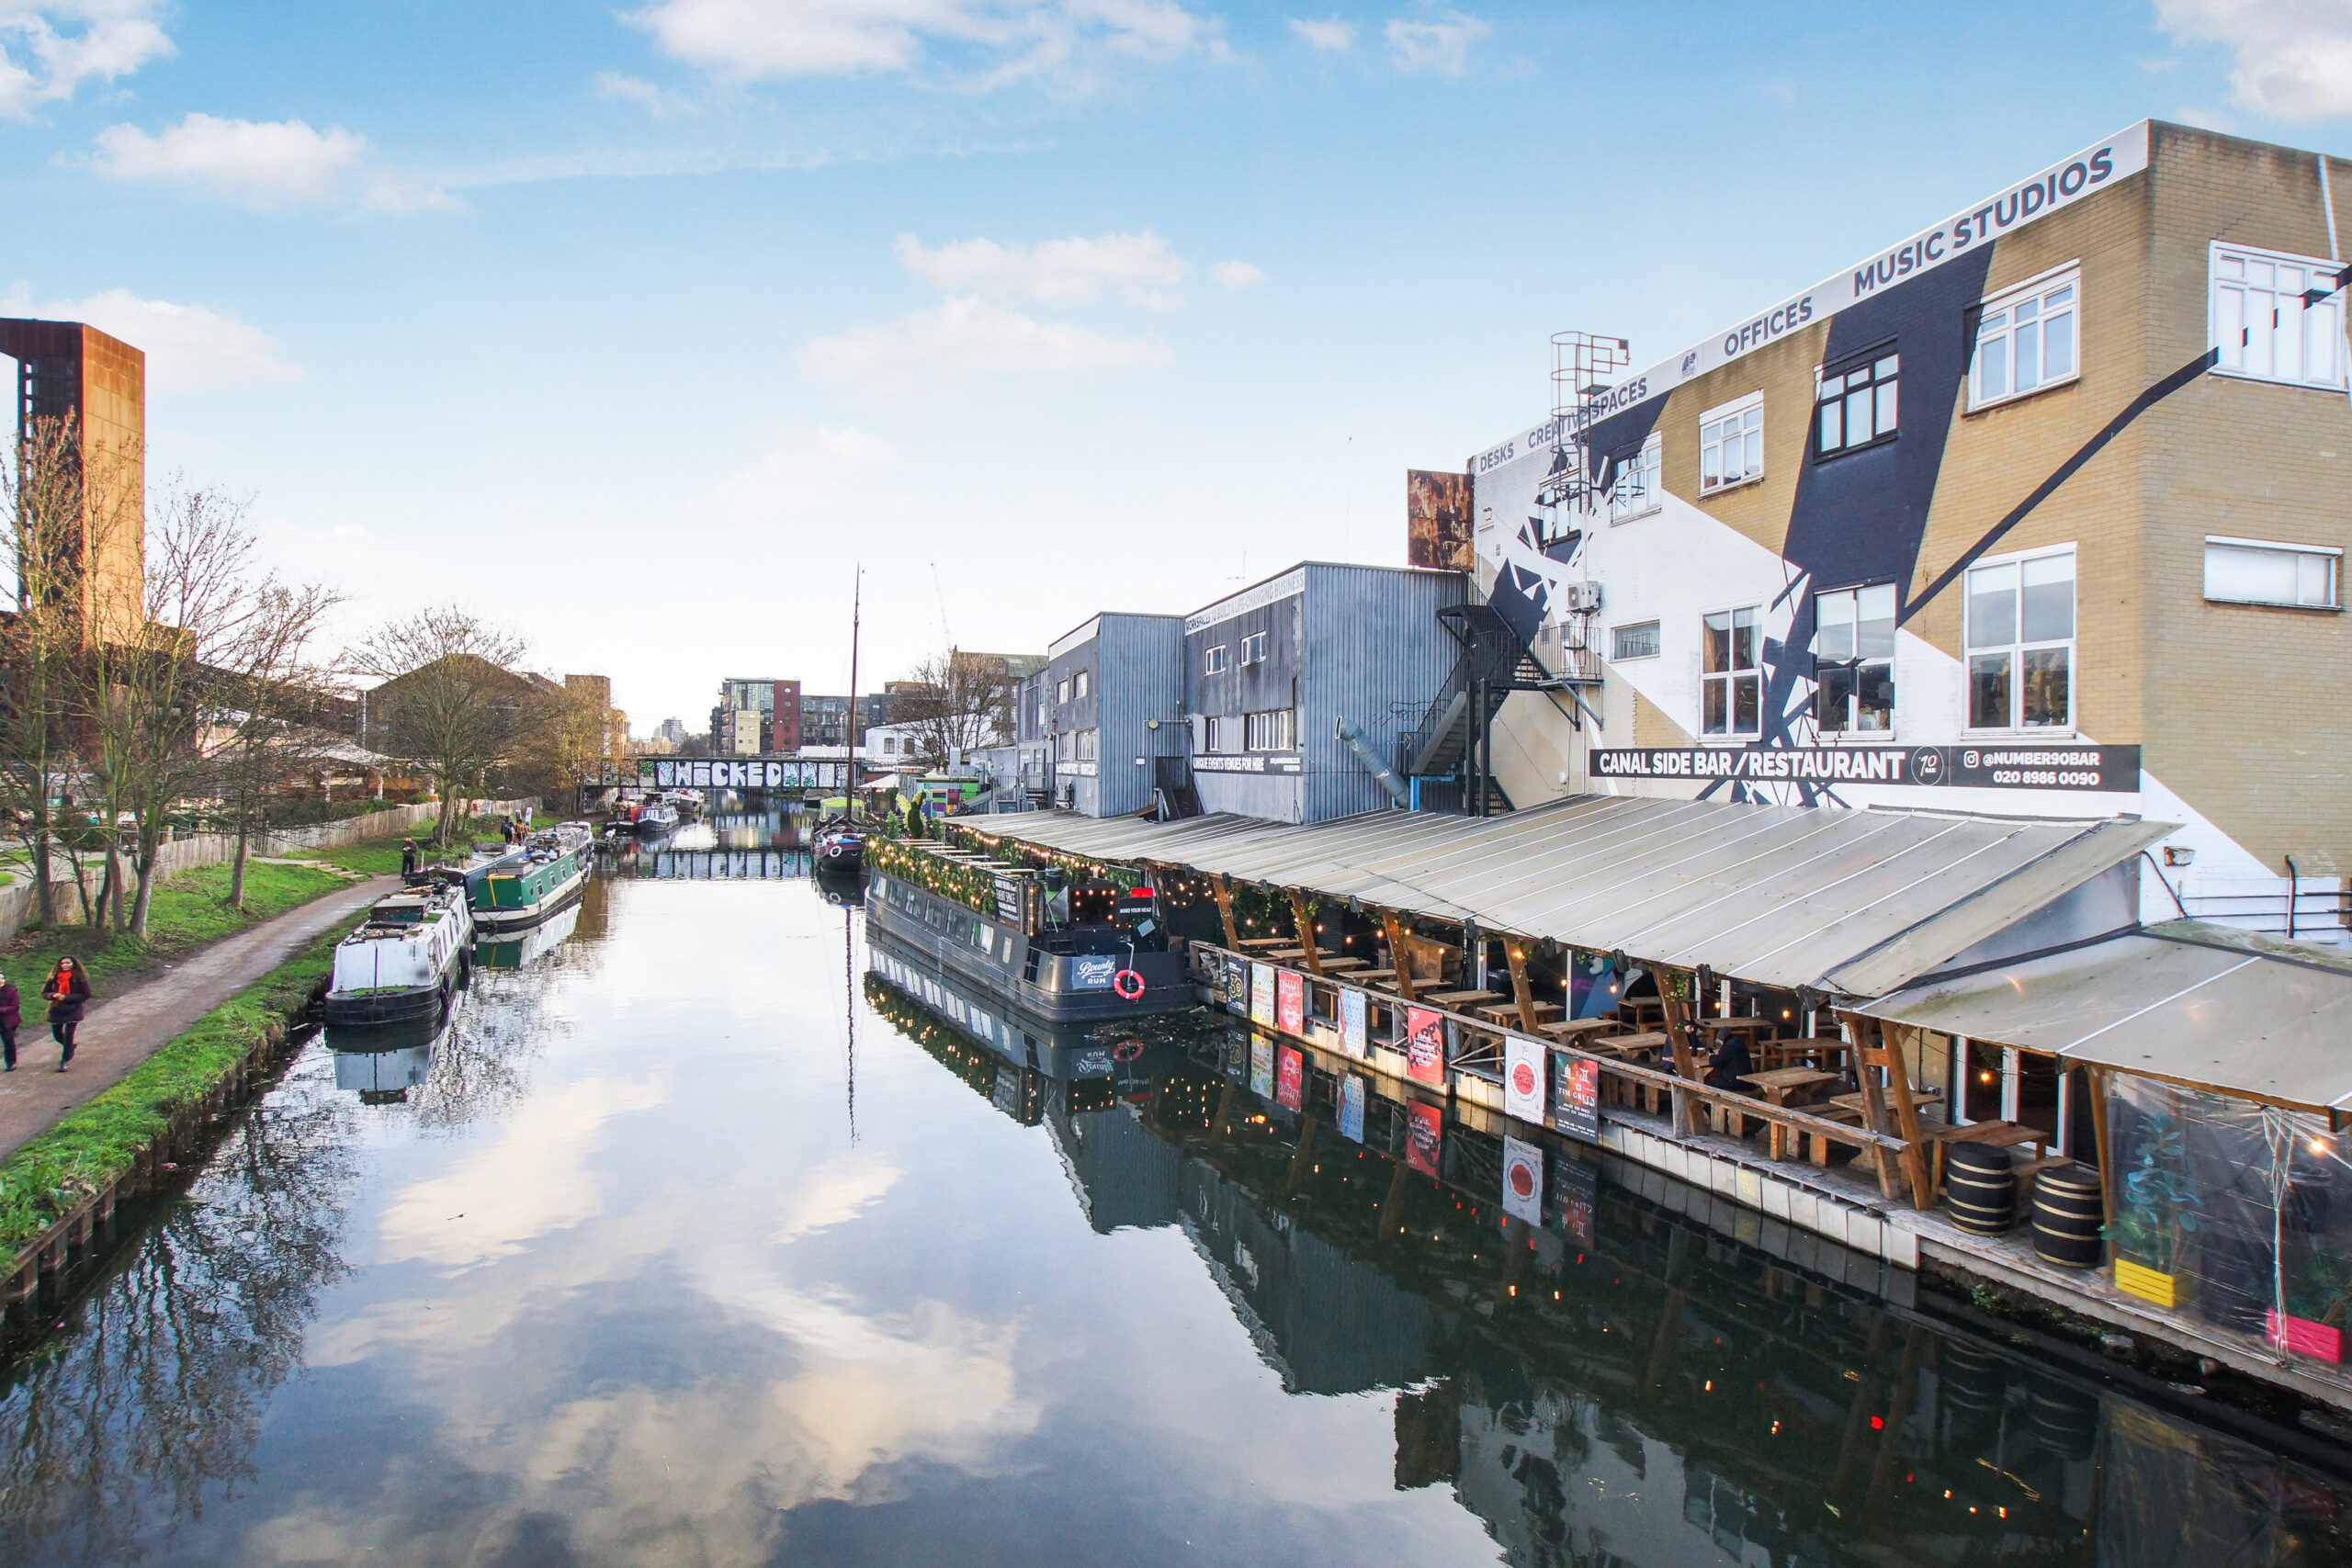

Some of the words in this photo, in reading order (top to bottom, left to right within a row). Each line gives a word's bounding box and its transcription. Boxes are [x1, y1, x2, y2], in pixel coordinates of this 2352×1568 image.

[1852, 231, 1946, 298] MUSIC
[1952, 146, 2113, 249] STUDIOS
[1724, 296, 1813, 356] OFFICES
[1528, 404, 1589, 449] CREATIVE
[1590, 377, 1647, 419] SPACES
[1479, 442, 1514, 472] DESKS
[1274, 572, 1304, 597] BUSINESS
[1193, 757, 1208, 770] UNIQUE
[1208, 757, 1224, 771] EVENTS
[1224, 757, 1242, 771] VENUES
[1242, 757, 1252, 772] FOR
[1252, 757, 1265, 772] HIRE
[1599, 752, 1650, 775] CANAL
[1653, 751, 1691, 775] SIDE
[1983, 751, 2100, 766] @NUMBER90BAR
[1993, 771, 2020, 784] 020
[2022, 772, 2056, 785] 8986
[2058, 773, 2100, 786] 0090
[1077, 959, 1115, 978] Bounty
[1517, 1080, 1532, 1089] OFFER
[1557, 1087, 1570, 1097] TIM
[1572, 1091, 1595, 1103] GREEN
